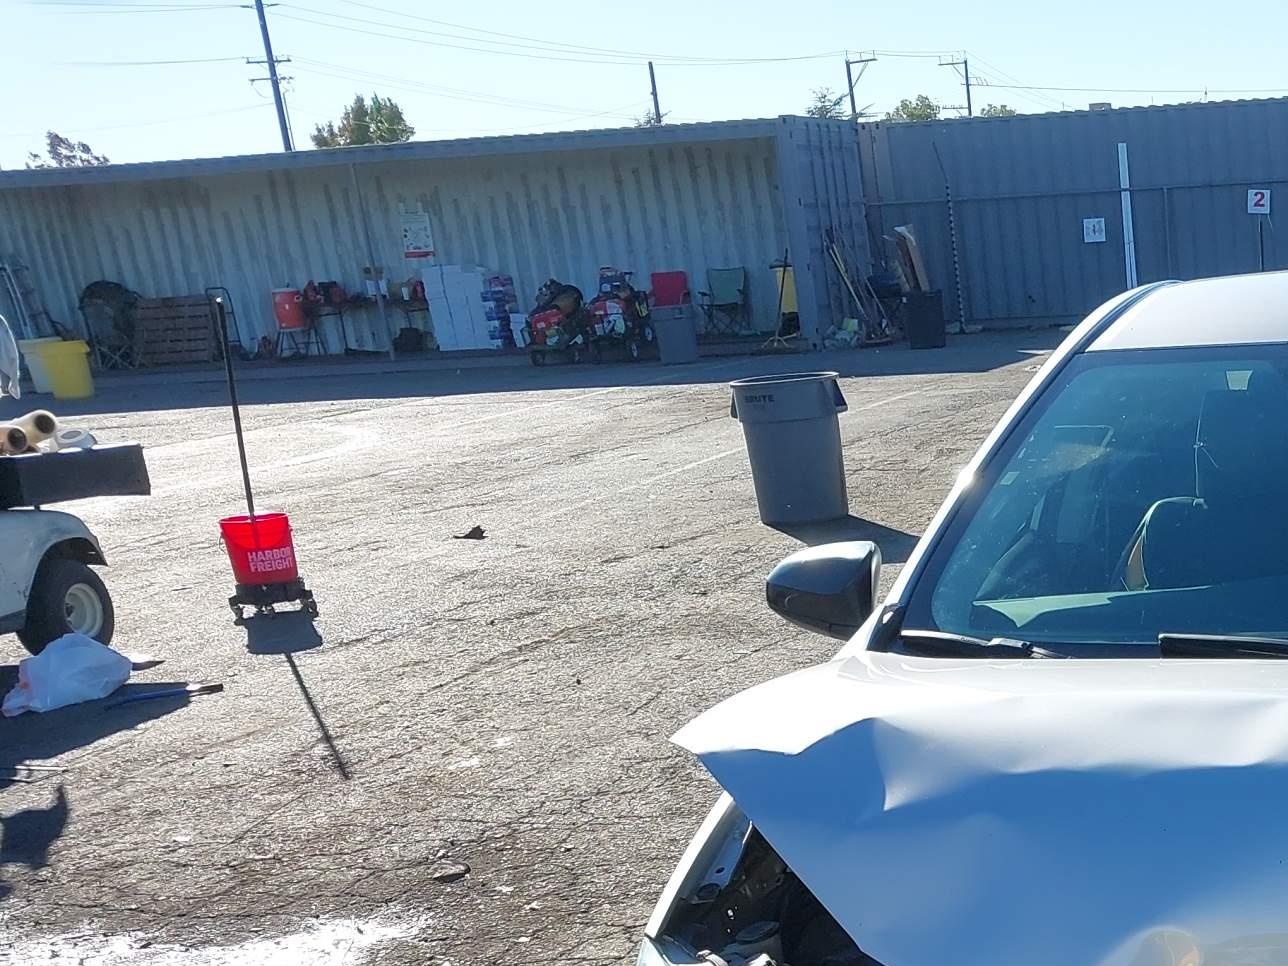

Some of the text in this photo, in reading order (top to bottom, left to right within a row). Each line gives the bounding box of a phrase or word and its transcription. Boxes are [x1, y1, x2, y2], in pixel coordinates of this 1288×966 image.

[1253, 191, 1265, 208] 2
[247, 547, 291, 562] HARBOR
[250, 557, 293, 572] FREIGHT
